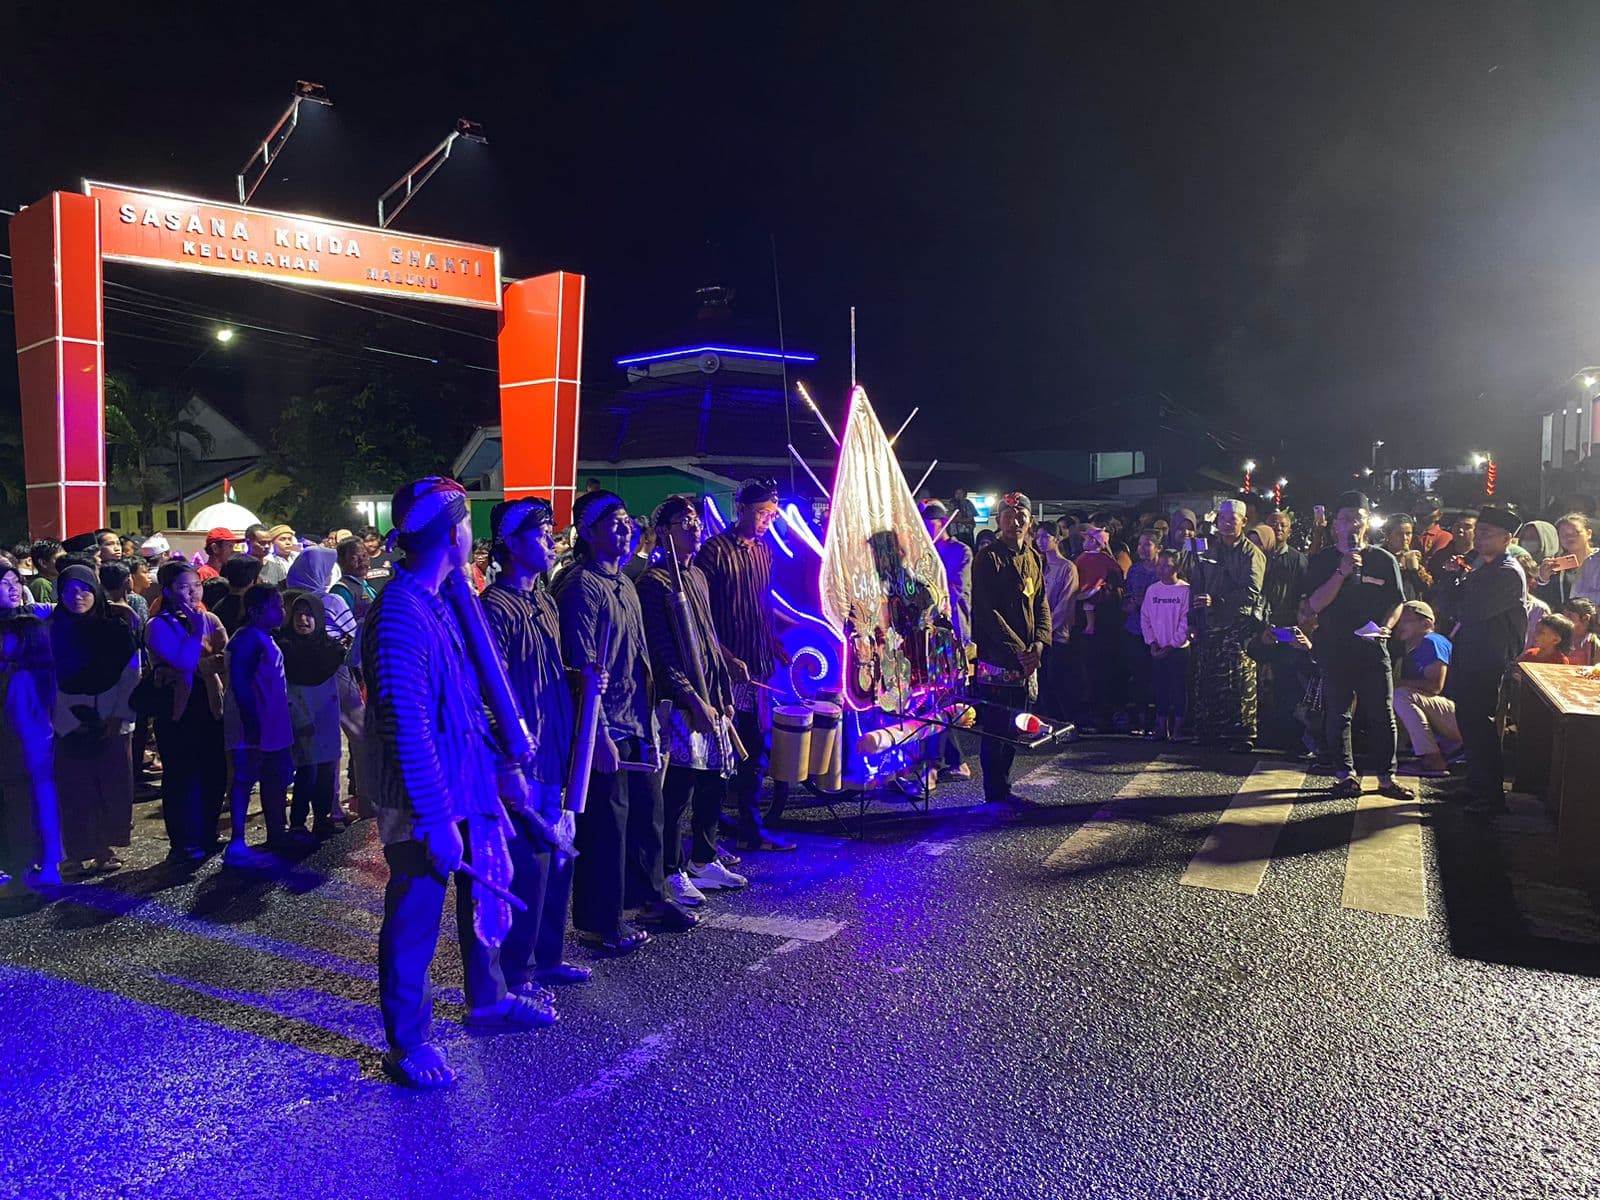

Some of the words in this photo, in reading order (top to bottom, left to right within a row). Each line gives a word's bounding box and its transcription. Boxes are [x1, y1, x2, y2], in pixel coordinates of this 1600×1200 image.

[119, 203, 249, 241] SASANA
[274, 227, 361, 258] KRIDA
[390, 247, 482, 276] BHAKTI
[183, 240, 320, 272] KELURAHAN
